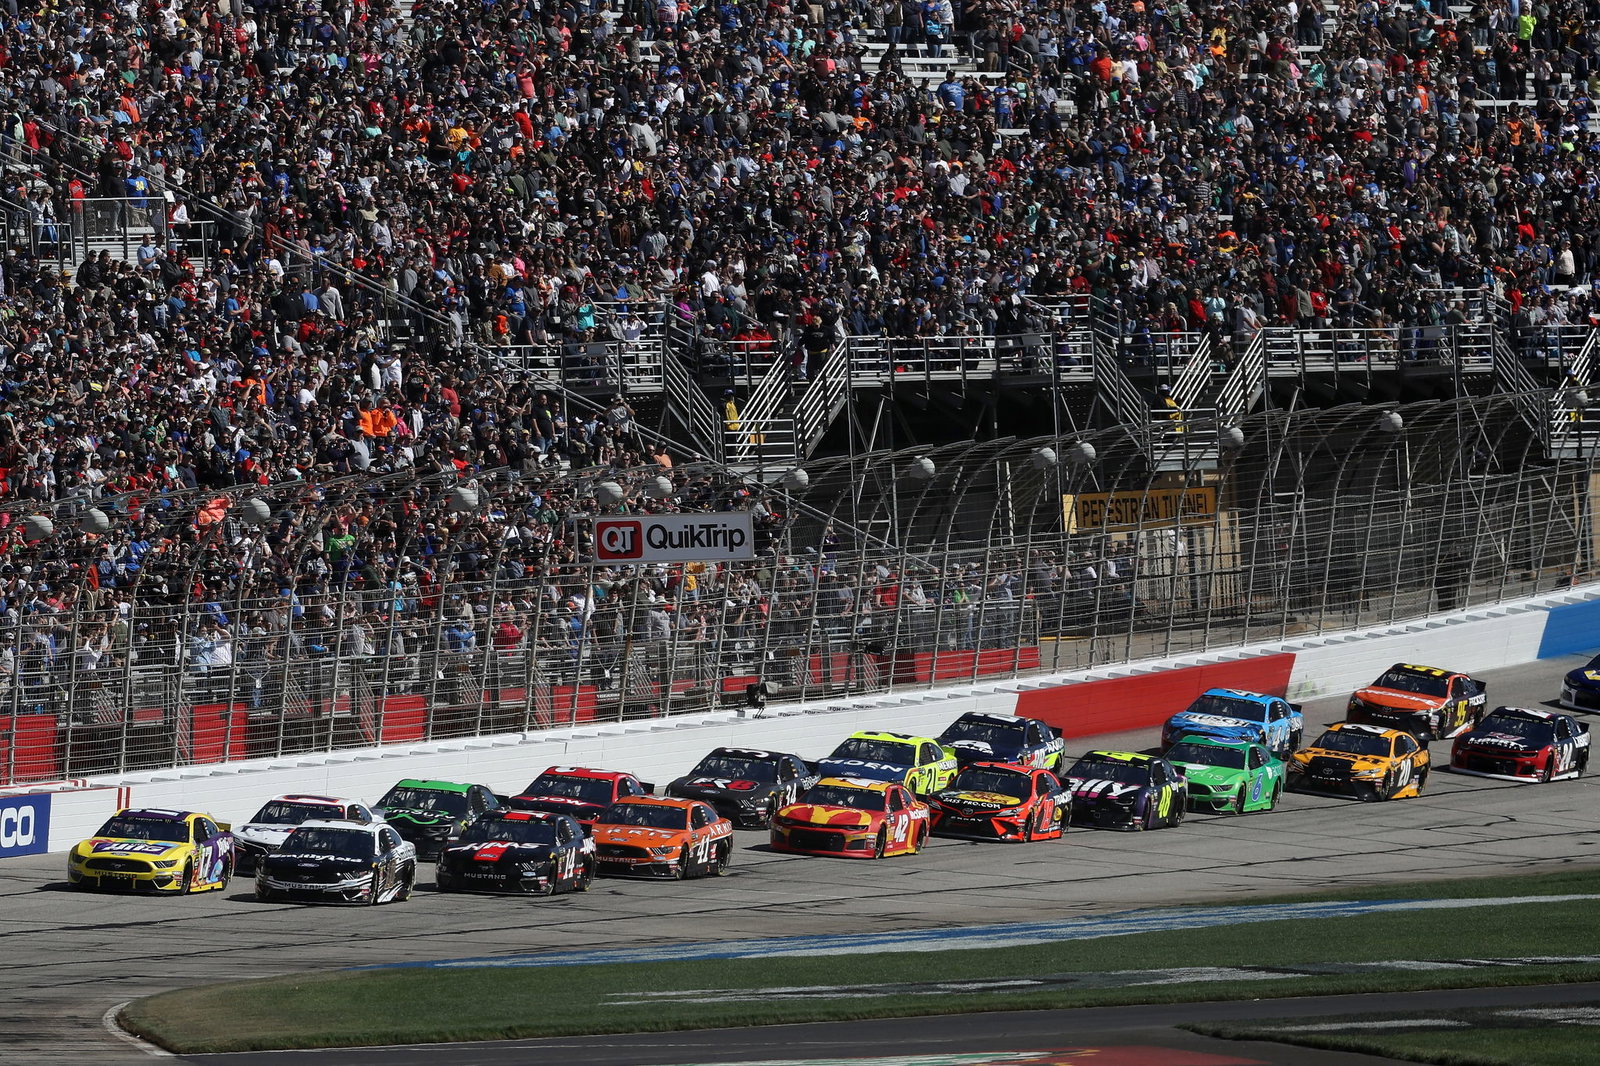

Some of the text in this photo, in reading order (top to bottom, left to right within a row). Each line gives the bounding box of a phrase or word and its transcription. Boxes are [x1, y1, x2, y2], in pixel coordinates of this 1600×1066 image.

[1081, 493, 1209, 527] PEDESTRIAN TUNNEL
[602, 526, 636, 554] QT
[647, 524, 746, 552] QuikTrip
[1183, 714, 1250, 727] BUSCH
[1454, 700, 1468, 727] 95
[819, 760, 904, 772] MOEN
[1398, 758, 1411, 787] 20
[786, 782, 797, 806] 34
[925, 767, 936, 796] 21
[1252, 772, 1264, 802] 6
[1158, 785, 1172, 818] 48
[0, 805, 35, 848] CO
[894, 814, 909, 842] 42
[697, 834, 710, 864] 41
[94, 870, 138, 879] MUSTANG
[464, 872, 507, 880] MUSTANG
[563, 847, 576, 880] 14
[284, 881, 328, 892] MUSTANG
